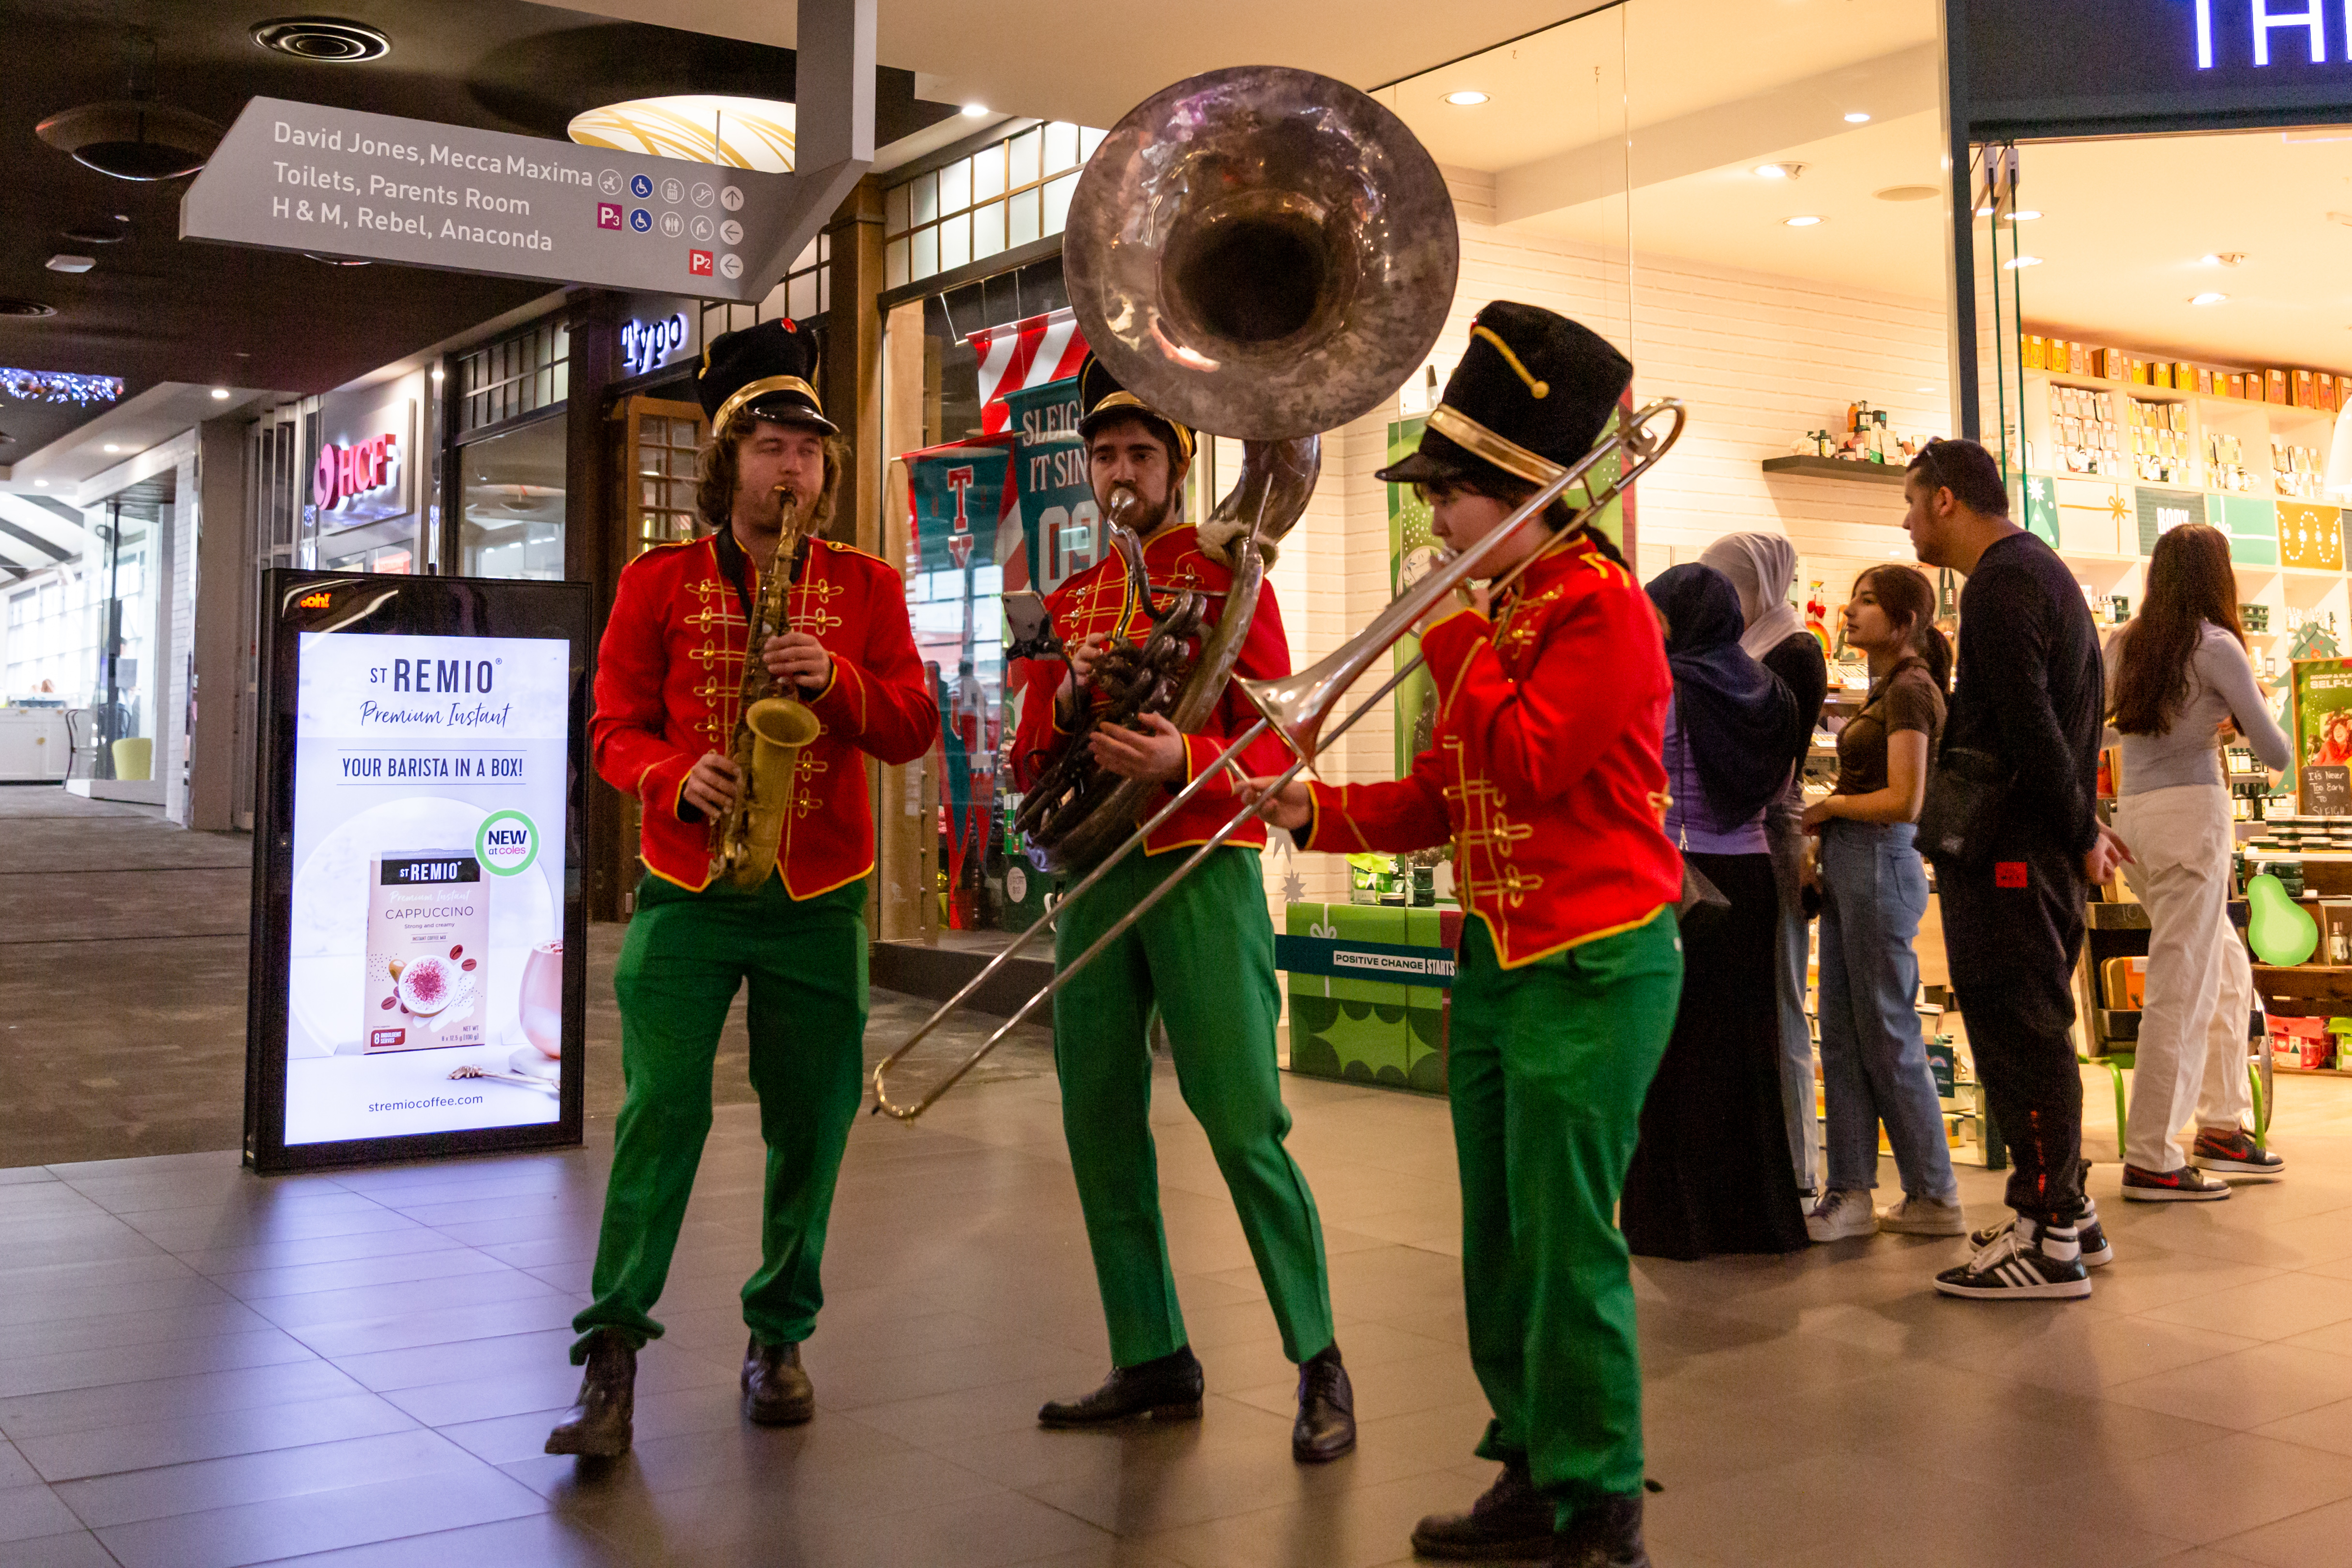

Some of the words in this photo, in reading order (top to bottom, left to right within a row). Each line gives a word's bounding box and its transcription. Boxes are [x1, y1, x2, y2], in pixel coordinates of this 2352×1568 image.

[2195, 0, 2352, 70] TH
[274, 121, 341, 151] David
[347, 133, 425, 166] Jones,
[430, 144, 501, 173] Mecca
[507, 155, 592, 187] Maxima
[273, 161, 361, 196] Toilets,
[370, 175, 458, 206] Parents
[466, 188, 529, 215] Room
[273, 196, 289, 218] H
[296, 200, 314, 222] &
[321, 203, 348, 229] M,
[358, 207, 432, 240] Rebel,
[440, 219, 552, 251] Anaconda
[620, 314, 688, 375] Typo
[338, 434, 396, 498] HCF
[1029, 453, 1051, 493] IT
[1055, 447, 1088, 488] SIN
[370, 668, 388, 683] ST
[2310, 679, 2352, 689] SELF-L
[360, 700, 444, 726] Premium
[447, 702, 514, 728] Instant
[343, 758, 382, 777] YOUR
[388, 758, 449, 777] BARISTA
[455, 758, 470, 777] IN
[476, 758, 485, 777] A
[492, 758, 523, 777] BOX!
[2325, 771, 2344, 780] Never
[2309, 783, 2323, 794] Too
[2326, 783, 2344, 793] Early
[488, 830, 527, 845] NEW
[499, 845, 526, 855] coles
[400, 868, 409, 877] ST
[390, 890, 433, 903] Premium
[437, 889, 472, 902] Instant
[386, 906, 474, 919] CAPPUCCINO
[1336, 954, 1379, 966] POSITIVE
[1381, 958, 1423, 969] CHANGE
[1427, 959, 1455, 976] STARTS
[374, 1033, 380, 1044] 8
[368, 1095, 483, 1112] stremiocoffee.com
